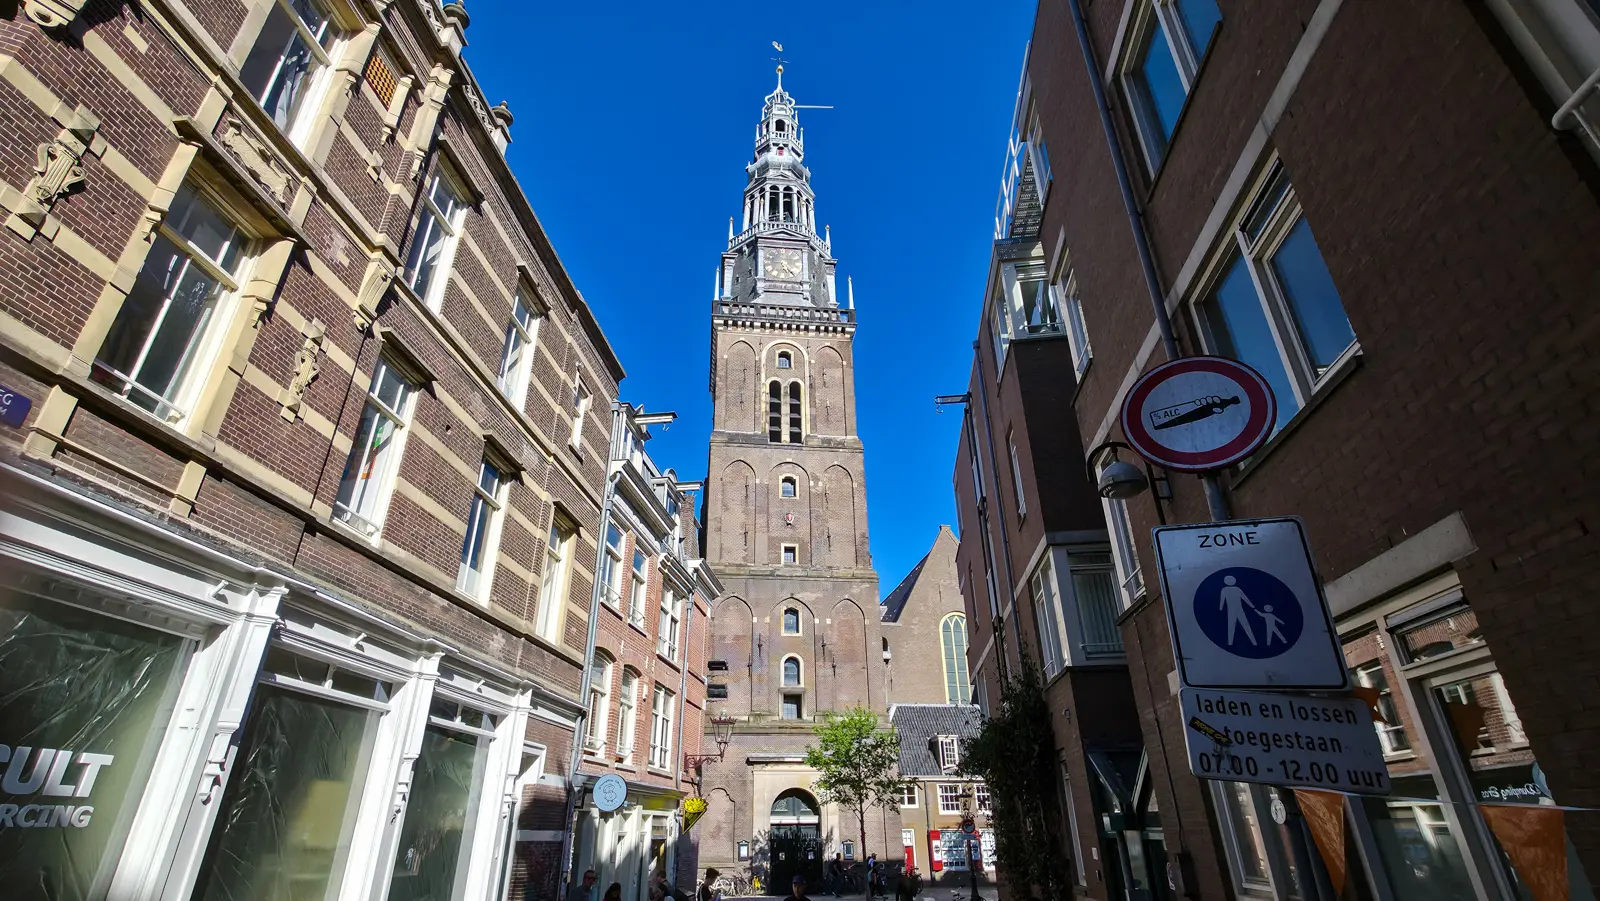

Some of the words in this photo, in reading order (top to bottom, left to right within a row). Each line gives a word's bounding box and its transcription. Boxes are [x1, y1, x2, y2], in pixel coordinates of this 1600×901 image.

[0, 389, 13, 405] G
[1164, 409, 1180, 418] ALC
[1197, 531, 1260, 549] ZONE
[1195, 693, 1252, 717] laden
[1259, 703, 1283, 720] en
[1290, 701, 1358, 725] lossen
[1223, 725, 1342, 753] toegestaan
[1199, 753, 1258, 776] 07.00
[1280, 760, 1339, 784] 12.00
[1347, 769, 1384, 789] uur
